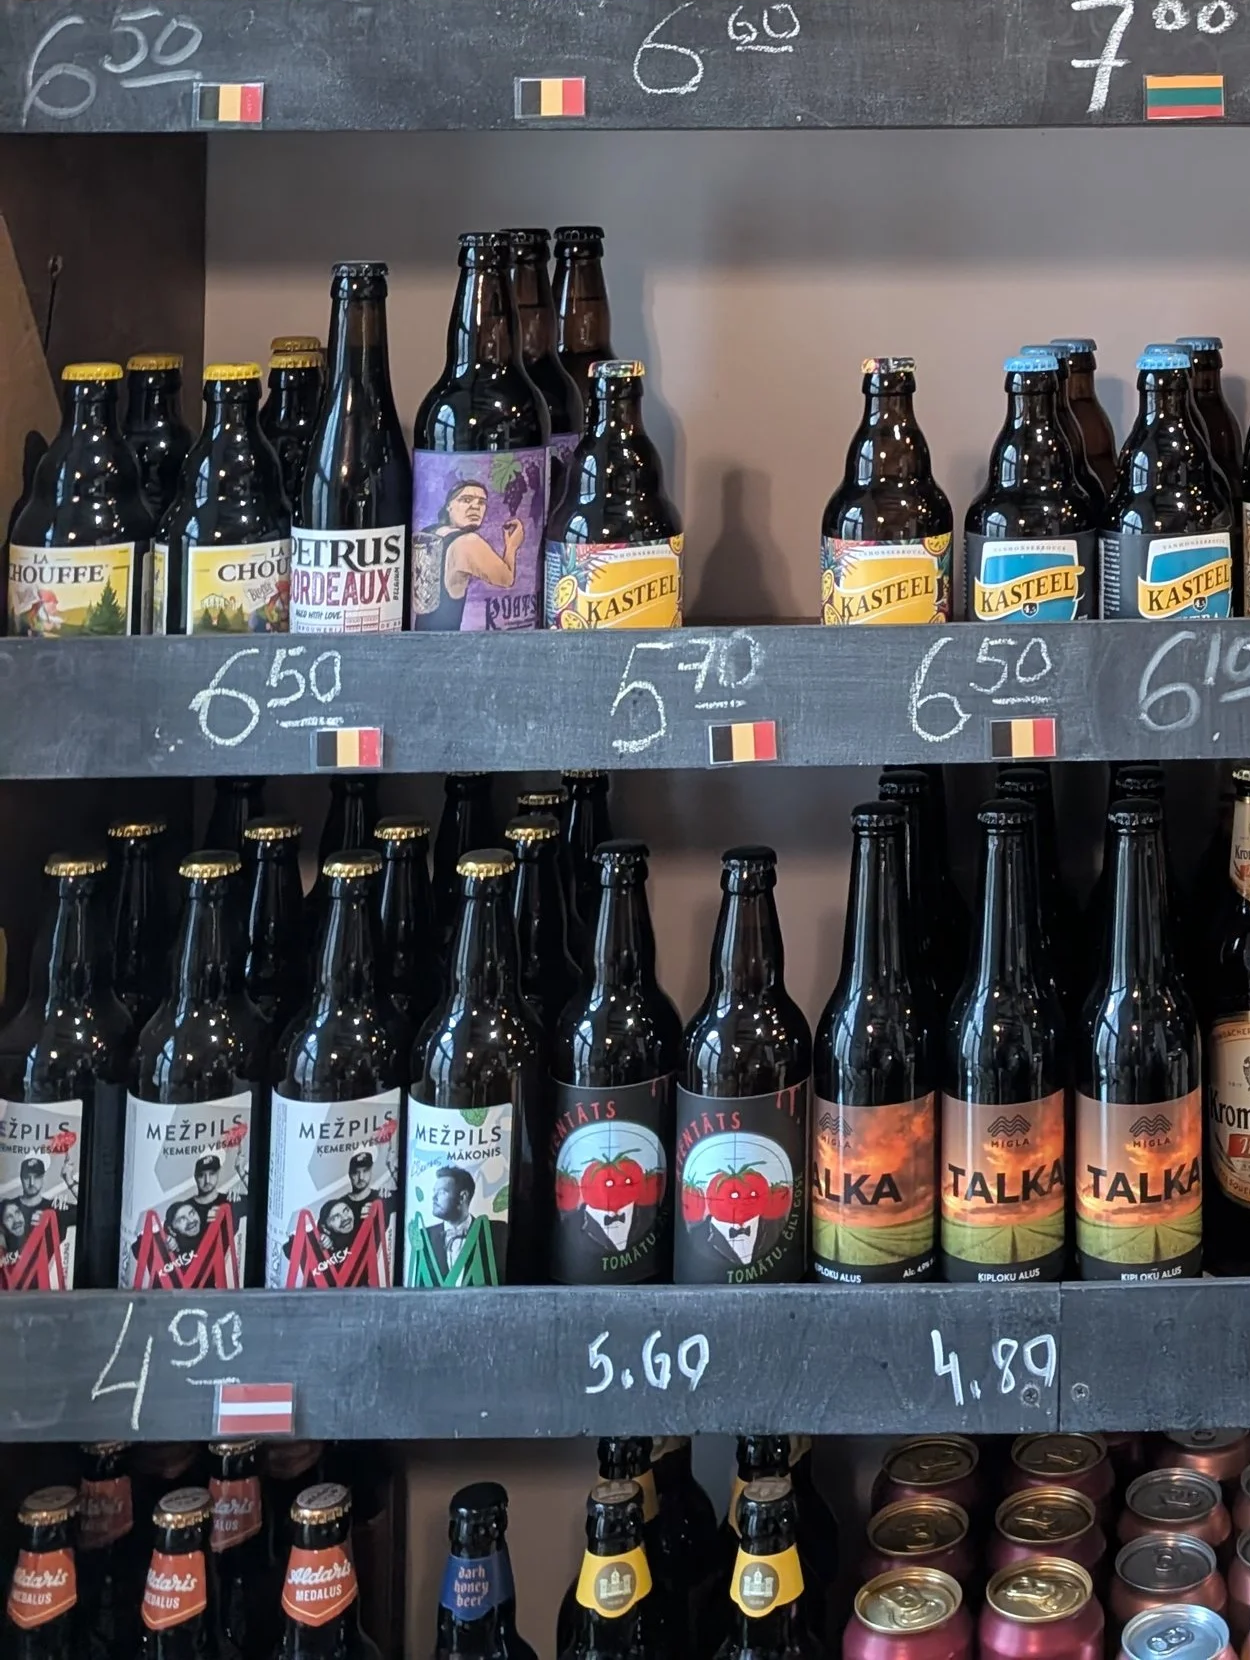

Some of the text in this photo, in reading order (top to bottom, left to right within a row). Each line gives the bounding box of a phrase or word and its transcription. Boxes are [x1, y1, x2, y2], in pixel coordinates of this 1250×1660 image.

[33, 553, 49, 565] LA
[271, 548, 285, 559] LA
[217, 560, 290, 582] CHOU
[289, 567, 392, 607] ORDEAUX
[981, 571, 1075, 613] KASTEEL
[1147, 563, 1230, 613] KASTEEL
[587, 574, 677, 623] KASTEEL
[841, 576, 935, 618] KASTEEL
[146, 1113, 244, 1143] MEŽPILS
[299, 1110, 393, 1141] MEŽPILS
[414, 1122, 502, 1147] MEŽPILS
[163, 1144, 207, 1159] ĶEMERU
[316, 1140, 359, 1157] ĶEMERU
[991, 1138, 1031, 1149] MIGLA
[1132, 1137, 1172, 1149] MIGLA
[447, 1146, 502, 1161] MĀKONIS
[812, 1162, 903, 1206] ALKA
[947, 1158, 1065, 1205] TALKA
[1086, 1156, 1201, 1205] TALKA
[839, 1272, 862, 1284] ALUS
[1018, 1267, 1041, 1280] ALUS
[288, 1560, 352, 1585] Aldaris
[457, 1565, 486, 1580] dark
[295, 1585, 342, 1602] MEDALUS
[453, 1578, 489, 1595] honey
[456, 1592, 483, 1608] beer
